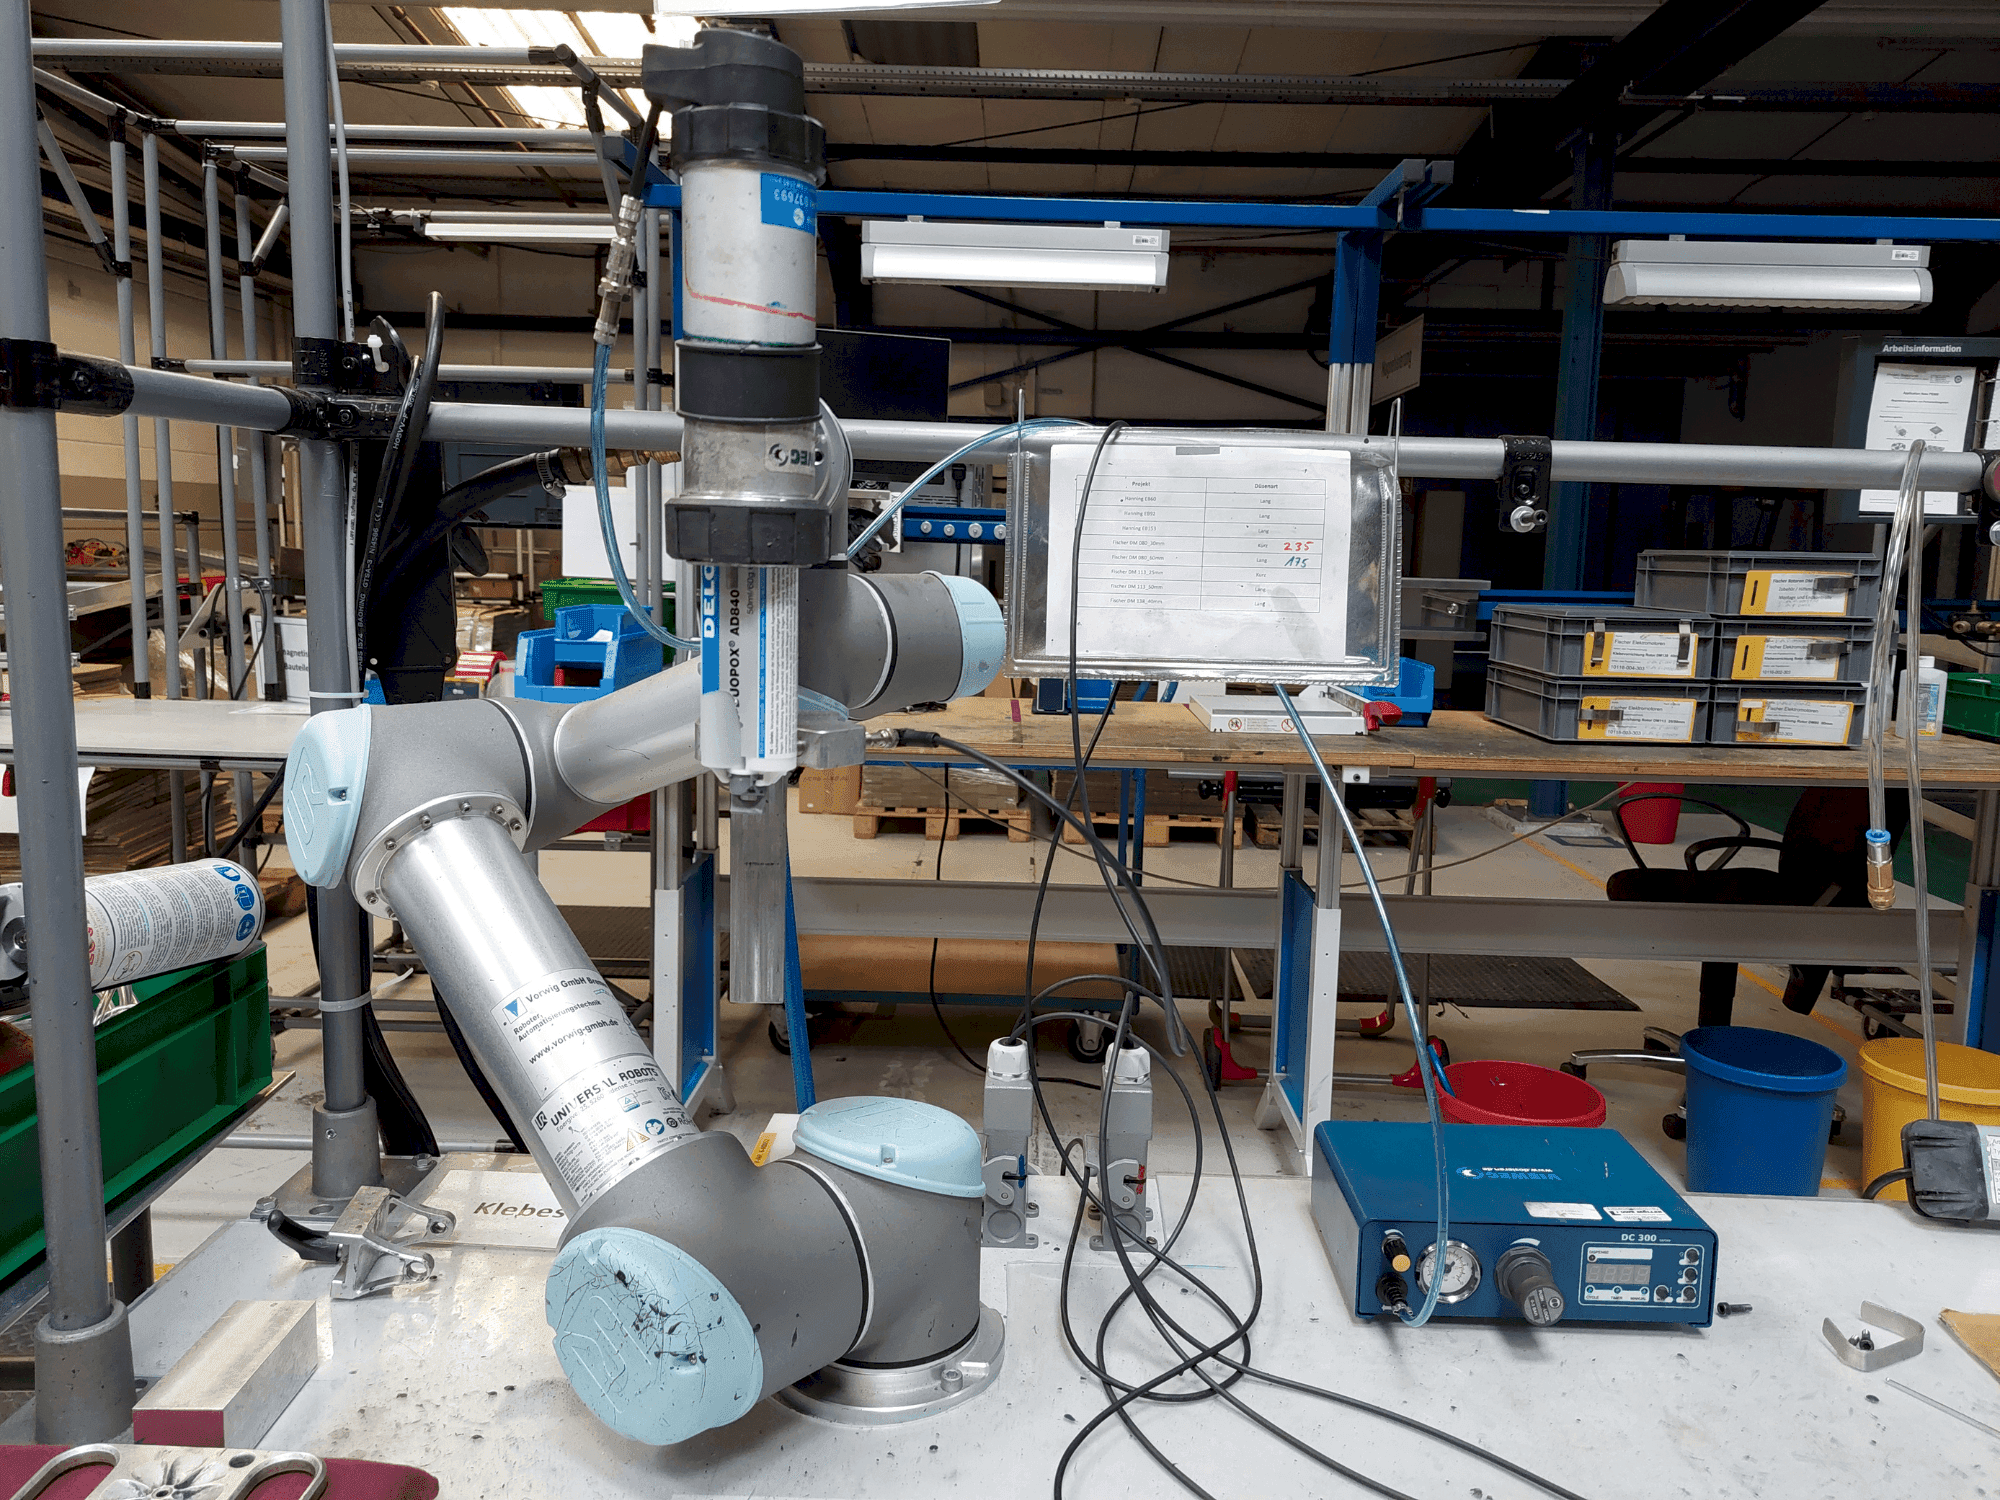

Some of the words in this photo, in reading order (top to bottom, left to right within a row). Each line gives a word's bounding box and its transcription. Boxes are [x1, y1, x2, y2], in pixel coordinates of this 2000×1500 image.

[1883, 345, 1961, 353] Arbeitsinformation
[1284, 541, 1314, 551] 235
[1284, 556, 1309, 568] 175
[730, 590, 740, 636] AD840
[729, 641, 740, 707] UOPOX®
[525, 983, 560, 1003] Vorwig
[560, 976, 586, 989] GmbH
[513, 1012, 544, 1035] Roboter,
[518, 999, 602, 1042] Automatisierungstechnik
[529, 1019, 619, 1064] www.vorwig-gmbh.de
[618, 1068, 659, 1082] ROBOTS
[610, 1083, 628, 1093] dense
[1621, 1233, 1636, 1241] DC
[1638, 1234, 1657, 1242] 300
